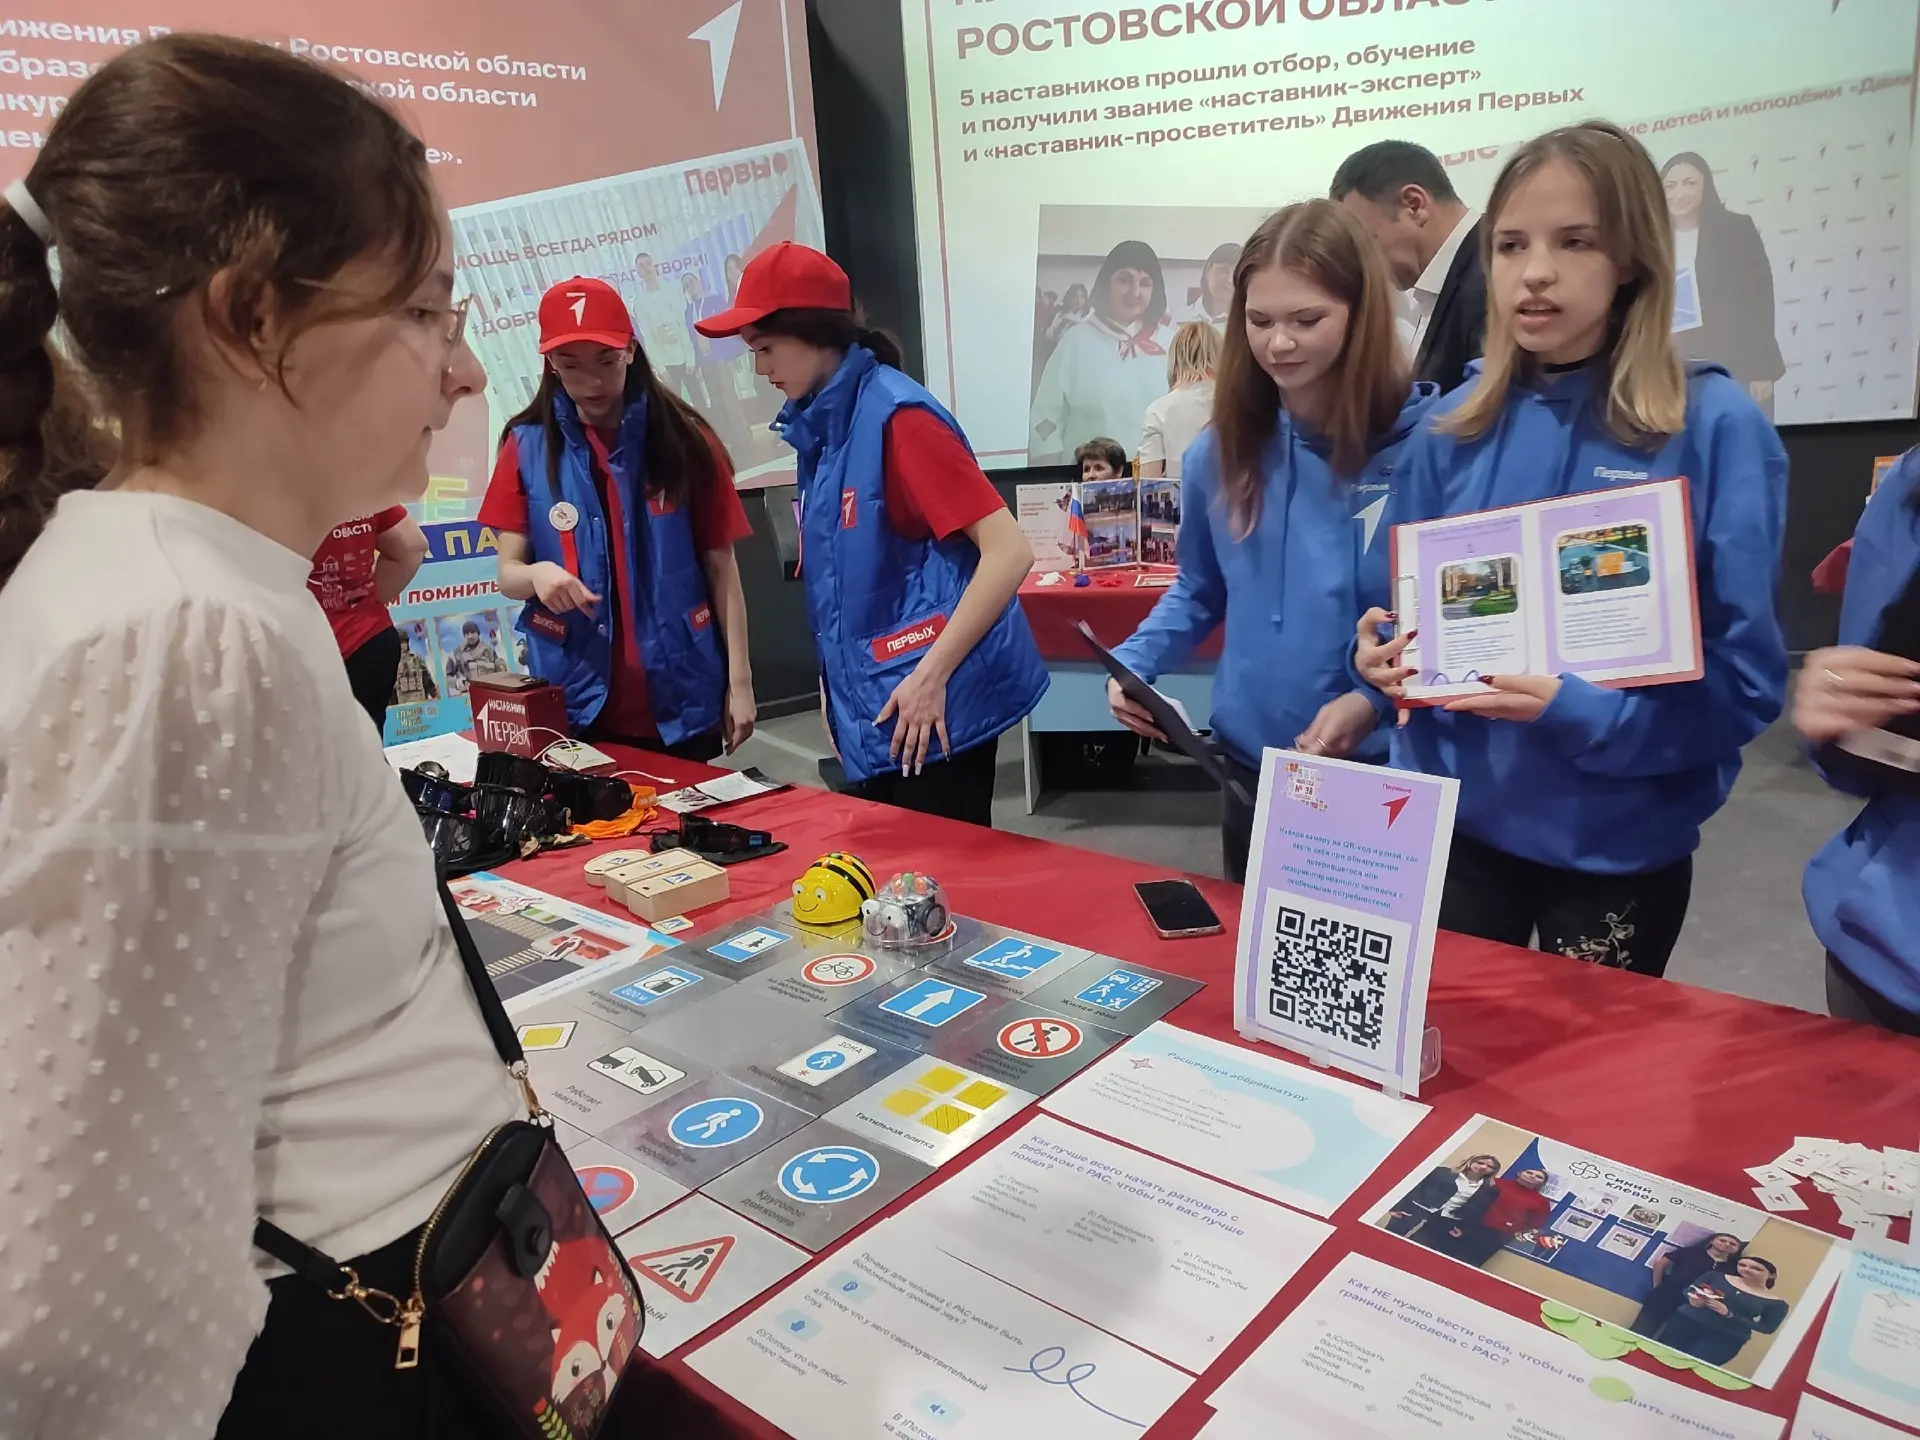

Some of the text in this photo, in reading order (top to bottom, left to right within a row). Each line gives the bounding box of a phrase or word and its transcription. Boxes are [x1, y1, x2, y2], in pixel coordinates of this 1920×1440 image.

[476, 55, 587, 81] области
[960, 39, 1476, 107] 5 наставников прошли отбор, обучение
[422, 82, 538, 107] области
[962, 69, 1482, 135] и получили звание «наставник-эксперт»
[963, 87, 1585, 162] и «наставник-просветитель» Движения Первых
[1651, 109, 1712, 133] детей
[1716, 107, 1730, 119] и
[521, 237, 596, 261] ВСЕГДА
[597, 223, 658, 247] РЯДОМ
[887, 625, 936, 653] ПЕРВЫХ
[1331, 852, 1346, 862] при
[1332, 839, 1341, 847] на
[856, 1112, 935, 1150] Тактильная плитка
[1010, 1149, 1055, 1171] понял?
[1030, 1135, 1240, 1223] Как лучше всего начать разговор с
[1603, 1173, 1653, 1194] Синий
[1085, 1167, 1113, 1185] РАС,
[1116, 1180, 1156, 1202] чтобы
[1157, 1198, 1174, 1208] он
[1176, 1205, 1200, 1219] вас
[1201, 1215, 1245, 1237] лучше
[804, 1294, 825, 1310] слух
[860, 1252, 890, 1275] Почему
[890, 1271, 908, 1284] для
[908, 1280, 947, 1305] человека
[952, 1303, 972, 1318] РАС
[971, 1314, 999, 1333] может
[999, 1327, 1024, 1347] быть
[849, 1309, 865, 1321] что
[870, 1322, 890, 1337] него
[1338, 1287, 1394, 1316] границы
[1396, 1311, 1458, 1344] человека
[1471, 1344, 1511, 1365] РАС?
[1347, 1277, 1371, 1292] Как
[1371, 1287, 1394, 1301] НЕ
[1393, 1297, 1433, 1320] нужно
[1435, 1312, 1476, 1338] вести
[1478, 1334, 1513, 1356] себя,
[1518, 1352, 1564, 1376] чтобы
[1566, 1372, 1586, 1384] не
[793, 1350, 808, 1364] что
